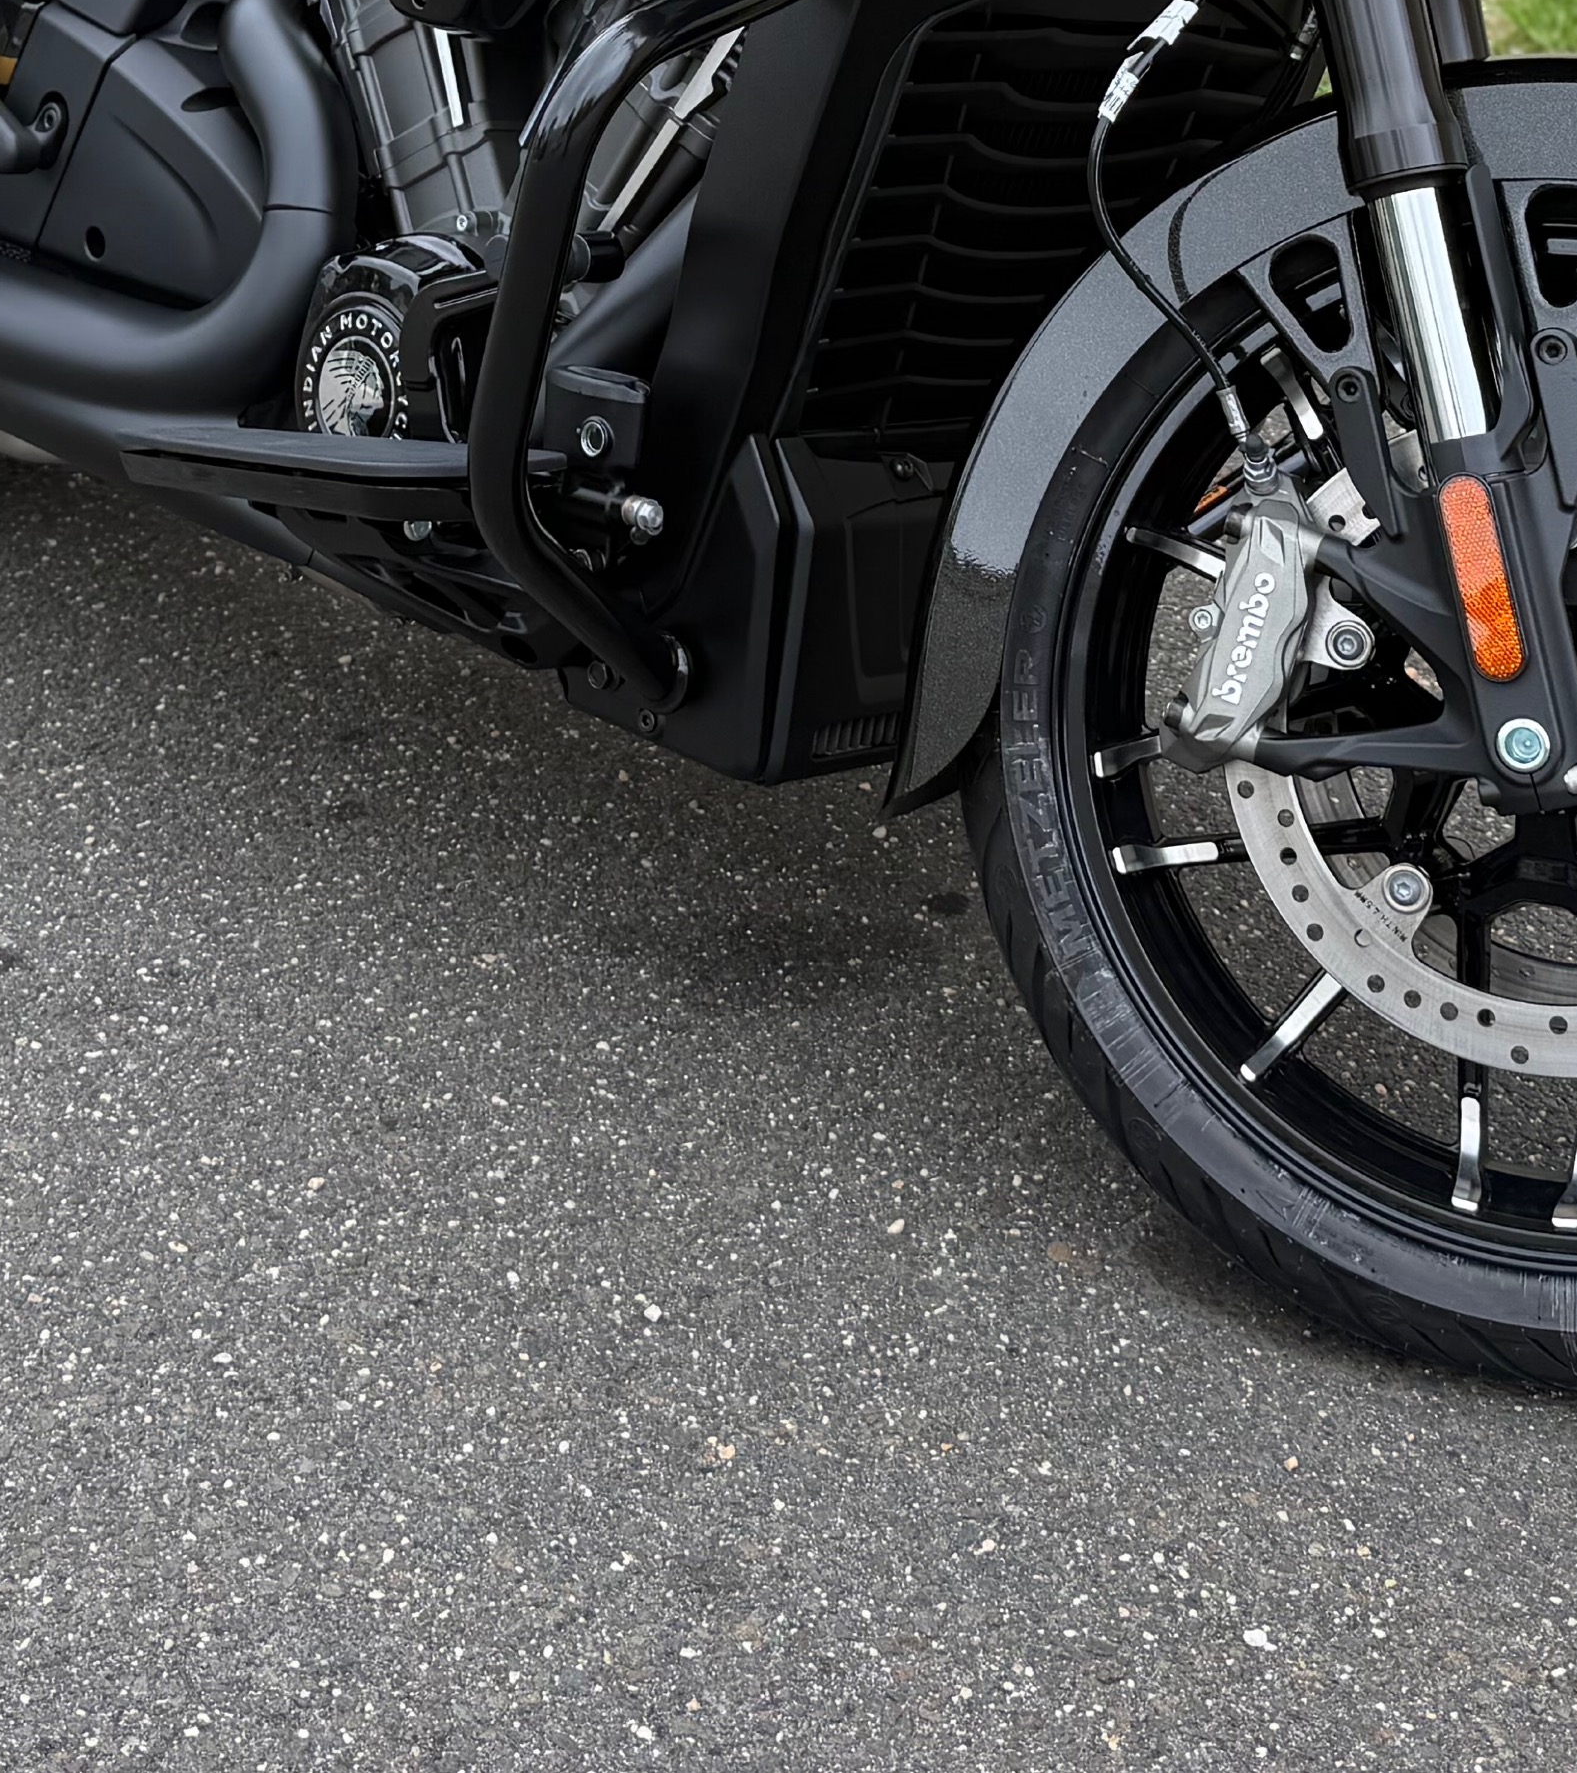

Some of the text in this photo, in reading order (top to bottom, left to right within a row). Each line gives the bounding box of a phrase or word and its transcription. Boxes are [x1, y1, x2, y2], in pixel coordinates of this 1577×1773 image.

[303, 325, 332, 432] INDIAN
[1211, 572, 1276, 705] brembo
[1012, 648, 1095, 960] METZELER
